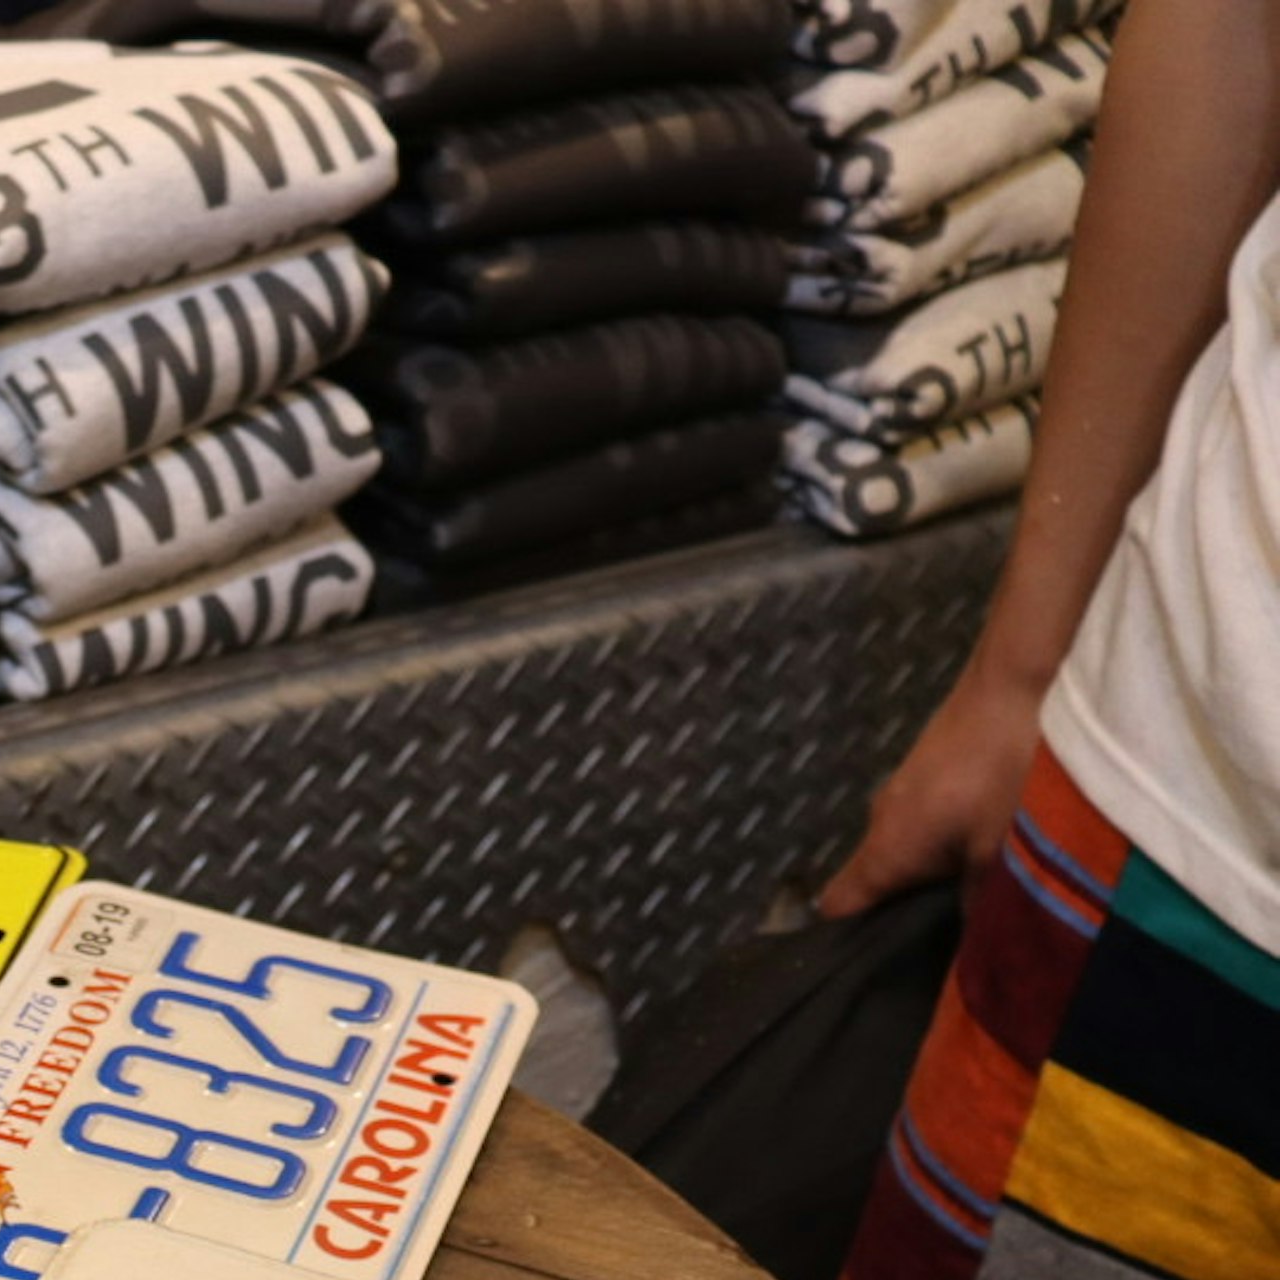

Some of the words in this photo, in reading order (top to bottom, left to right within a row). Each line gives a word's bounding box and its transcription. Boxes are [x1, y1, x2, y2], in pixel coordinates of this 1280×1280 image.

[74, 902, 130, 957] 08-19
[15, 992, 58, 1036] 1776
[312, 1013, 486, 1262] CAROLINA
